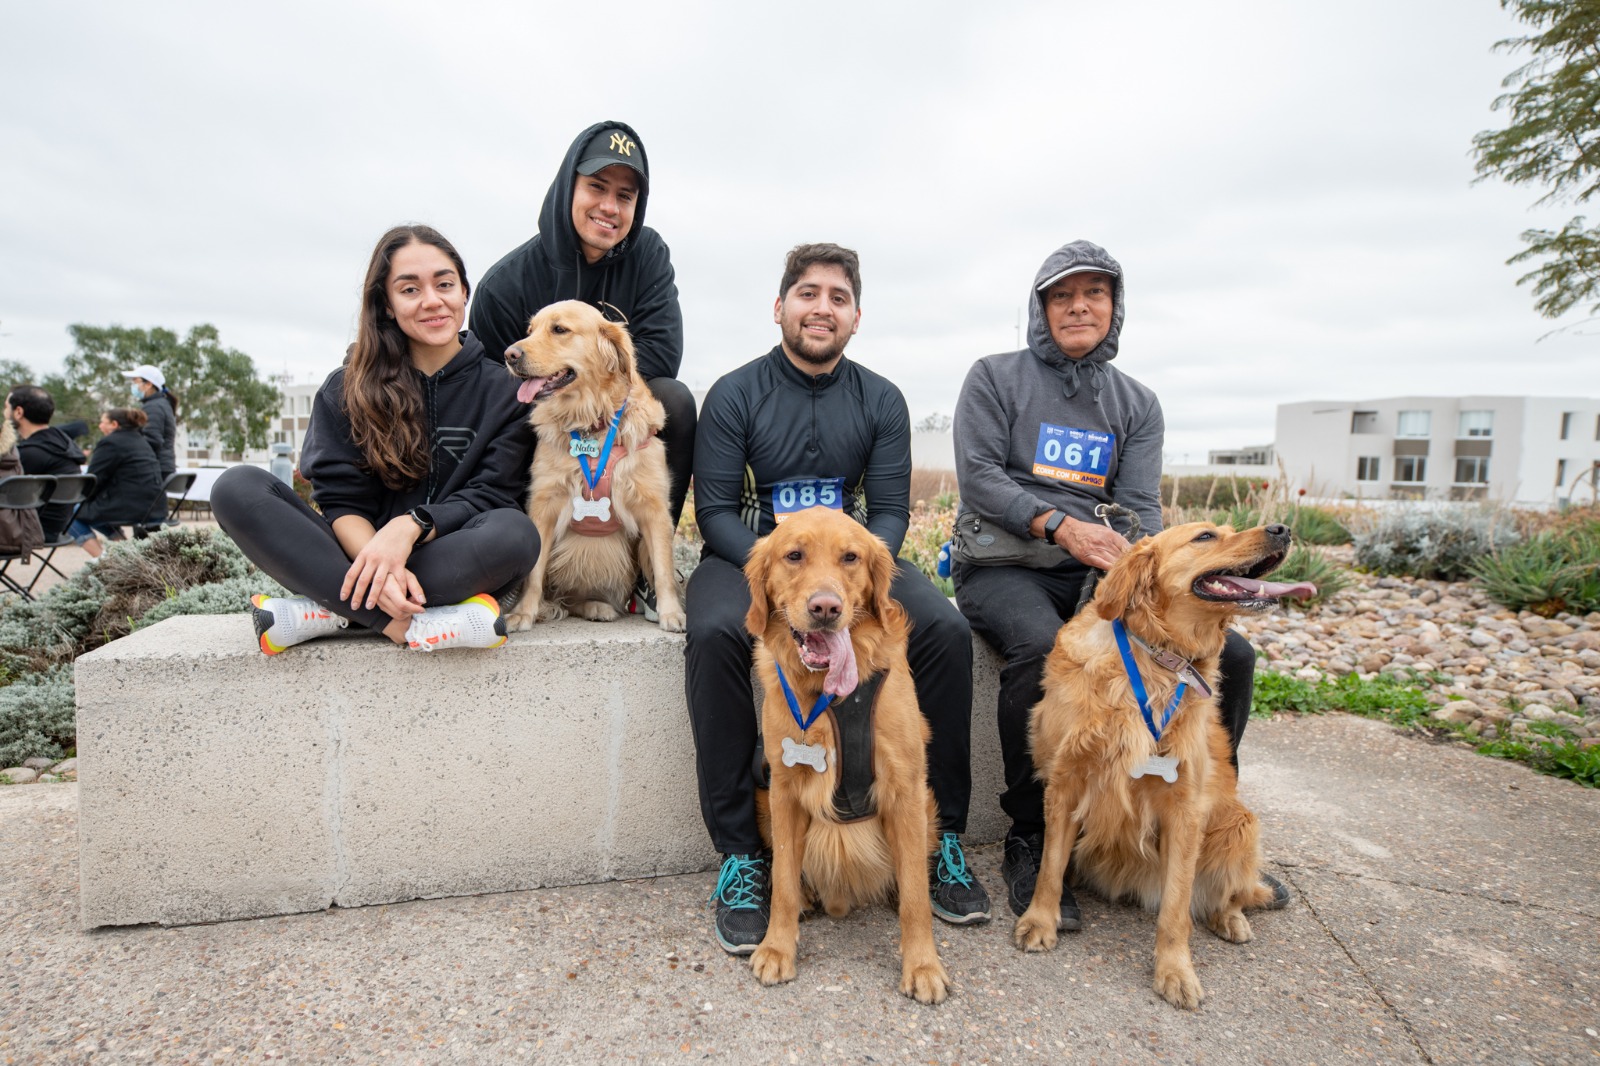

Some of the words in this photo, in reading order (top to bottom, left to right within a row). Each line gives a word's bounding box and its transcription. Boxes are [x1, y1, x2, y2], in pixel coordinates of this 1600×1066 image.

[609, 132, 636, 157] NY
[575, 443, 595, 453] Nala
[1044, 438, 1102, 470] 061
[1056, 471, 1070, 479] CON
[1080, 475, 1103, 486] AMIGO
[779, 484, 836, 508] 085
